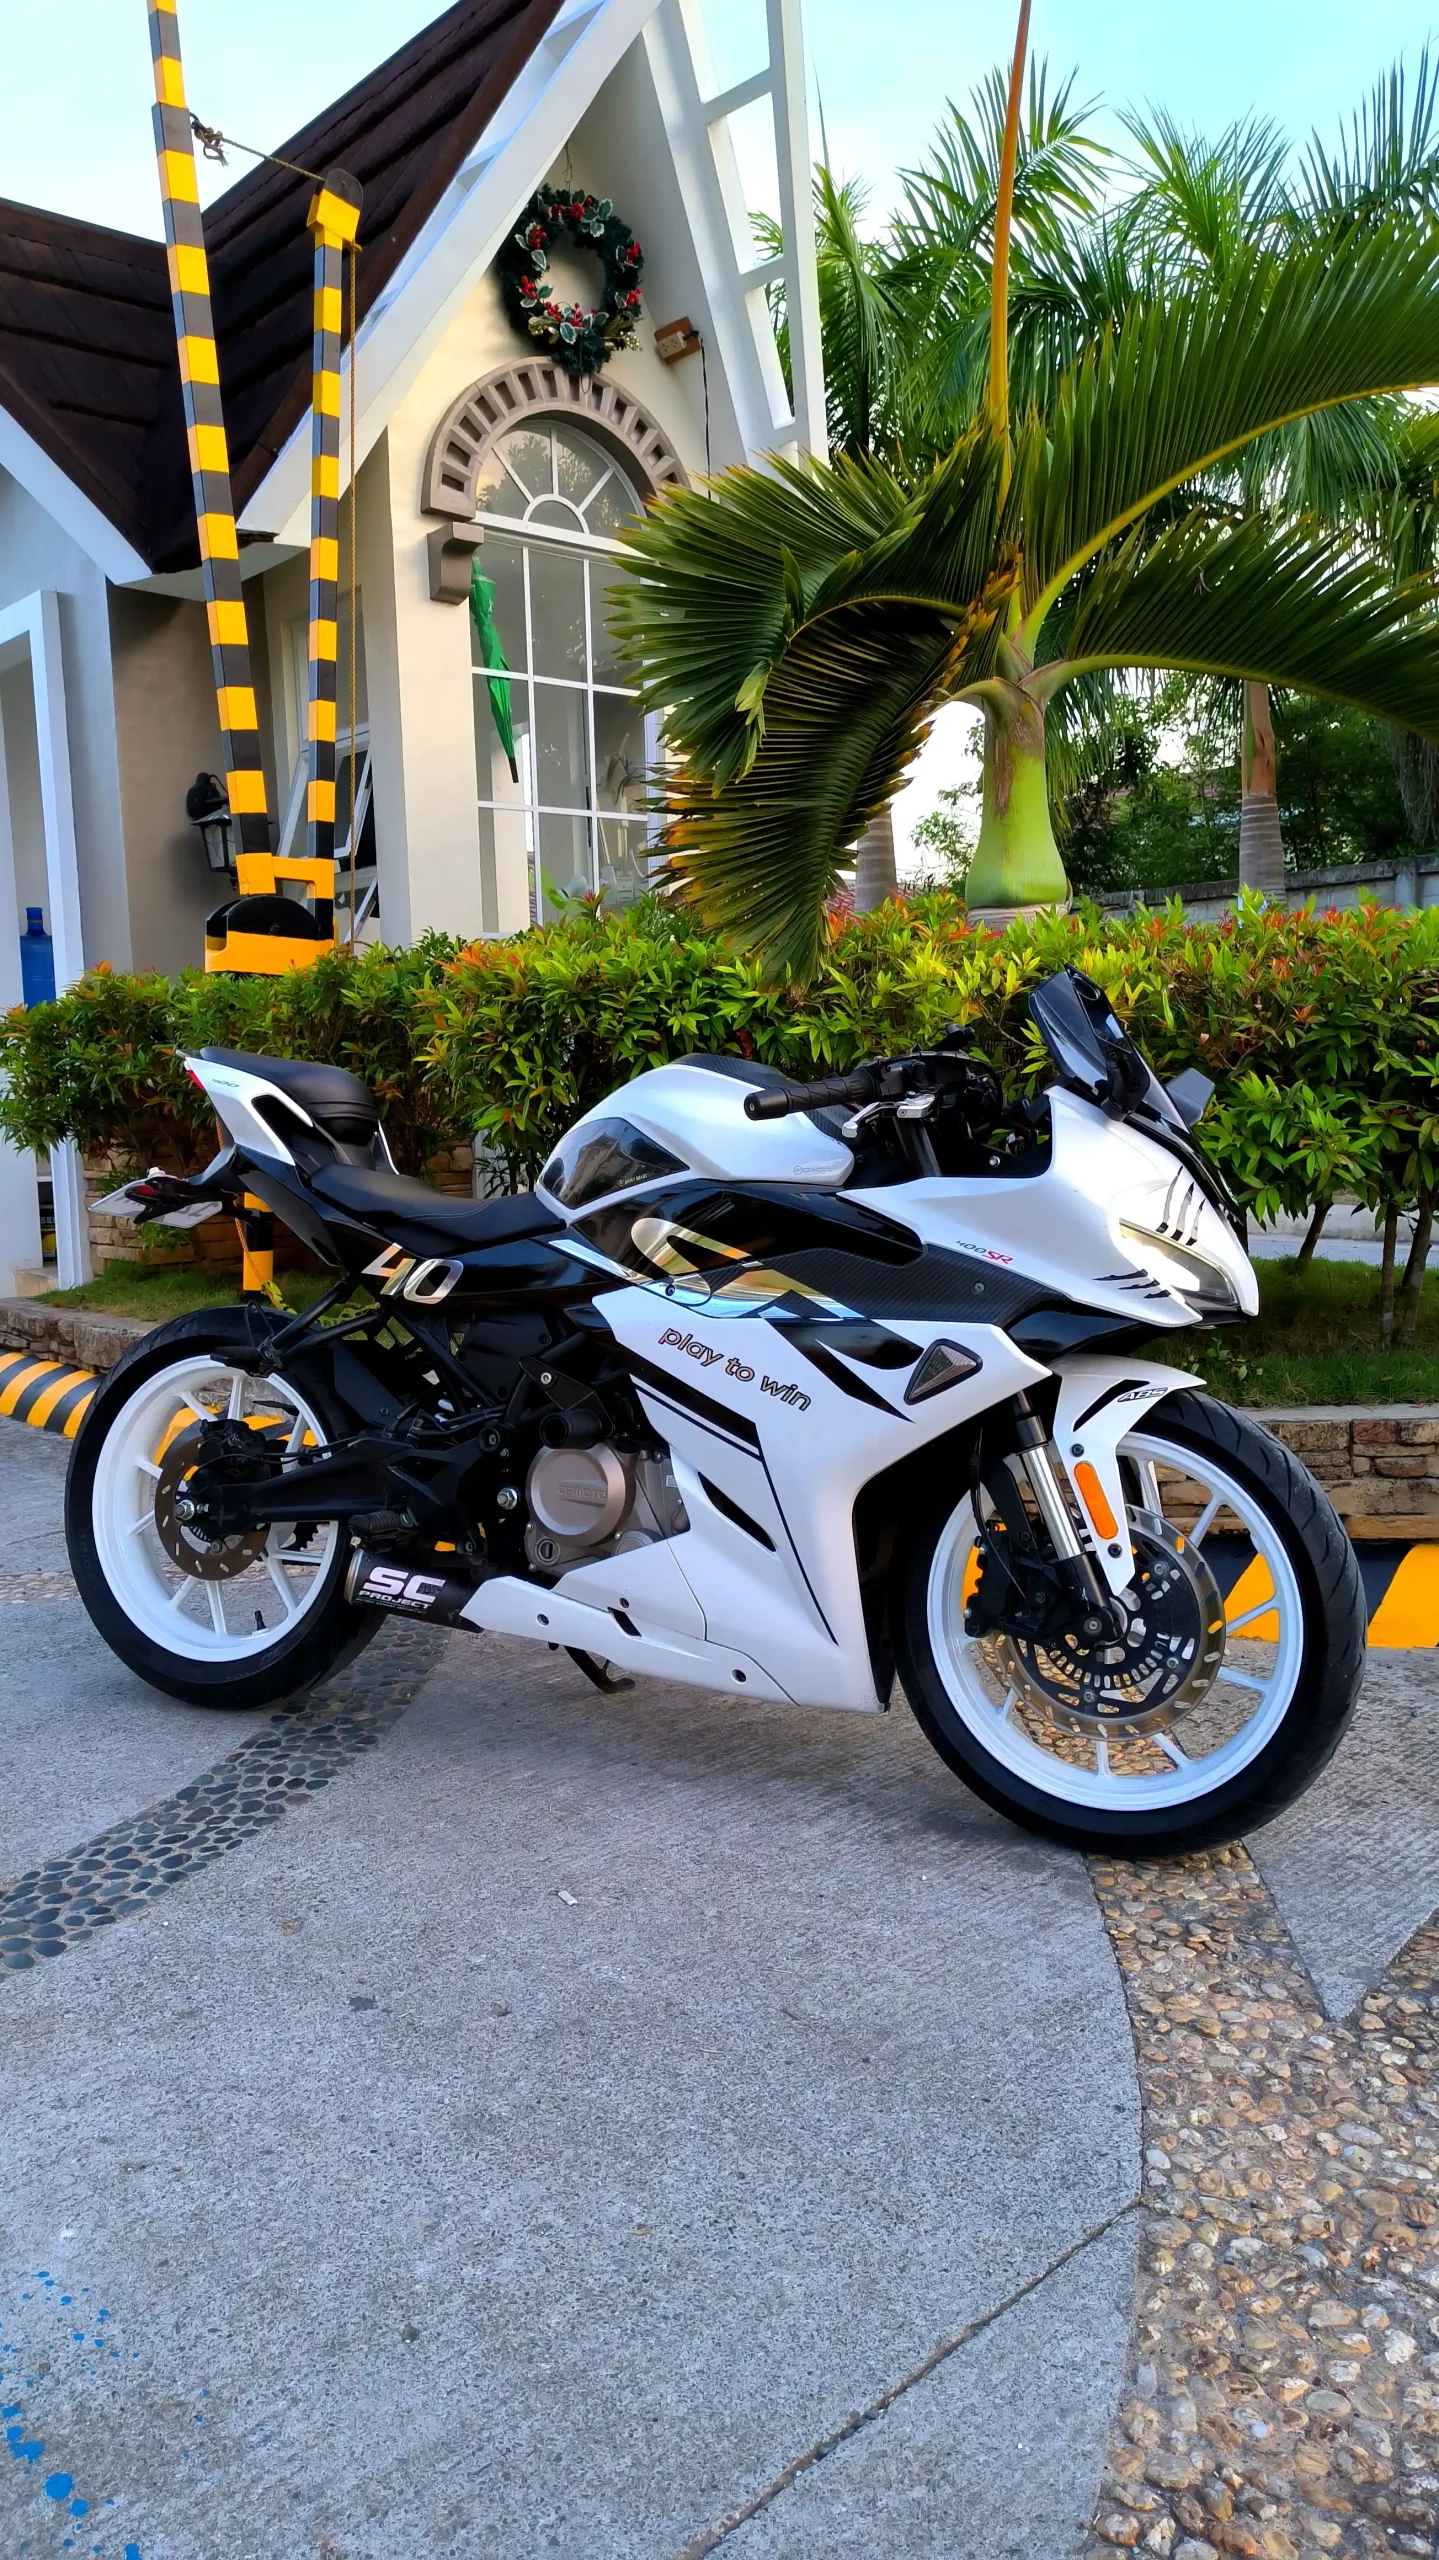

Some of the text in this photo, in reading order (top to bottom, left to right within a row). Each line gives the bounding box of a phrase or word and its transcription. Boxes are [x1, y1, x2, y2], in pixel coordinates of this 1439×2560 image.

[212, 1079, 240, 1088] 400
[956, 1240, 1013, 1264] 400SR
[361, 1242, 464, 1305] 40
[658, 1328, 812, 1411] play to win
[1119, 1388, 1167, 1401] ABS
[362, 1566, 446, 1603] SC
[359, 1590, 432, 1610] PROJECT
